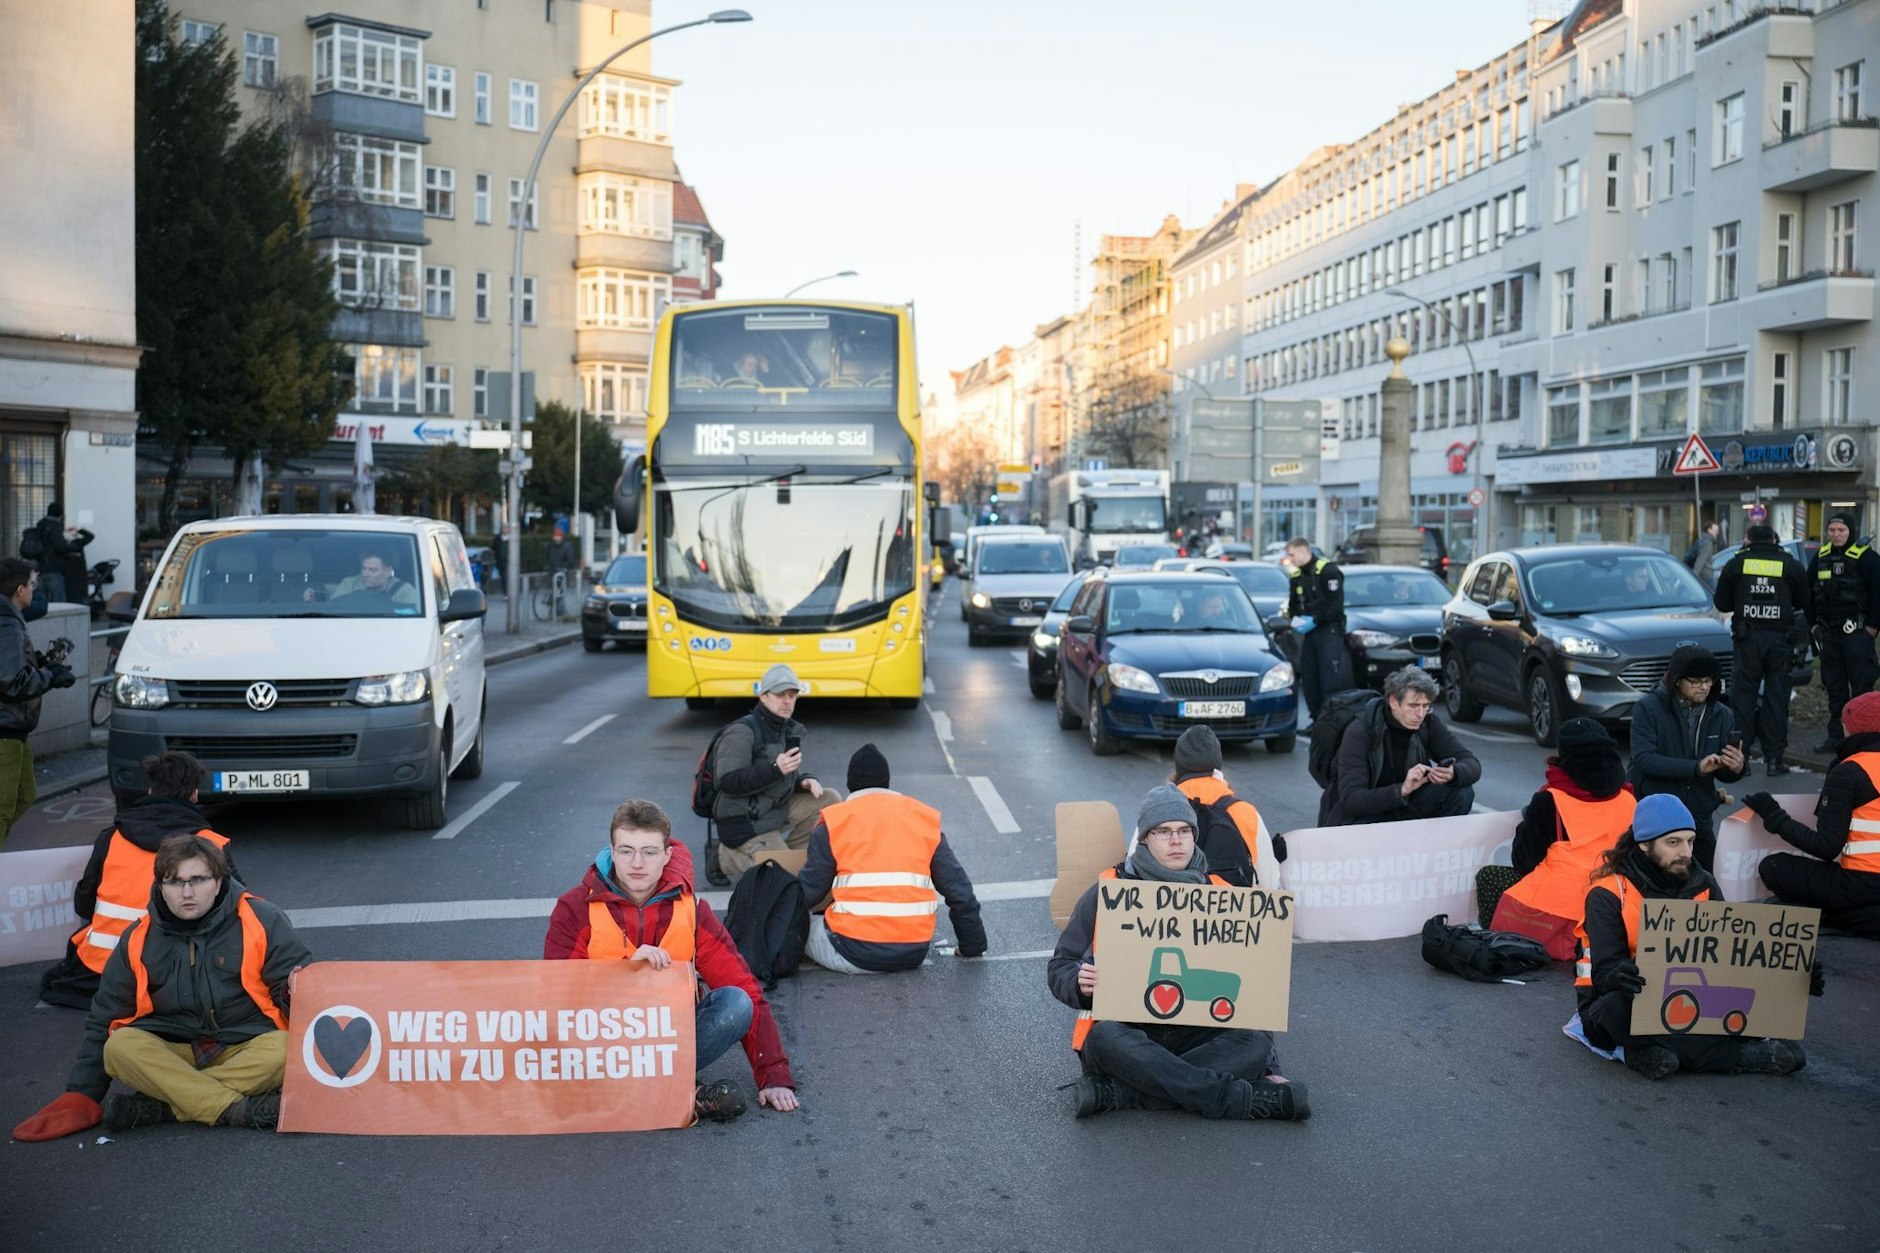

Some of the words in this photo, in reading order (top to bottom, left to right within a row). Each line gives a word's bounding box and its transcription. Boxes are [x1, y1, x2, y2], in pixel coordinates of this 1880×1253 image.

[695, 424, 735, 455] M85
[738, 431, 750, 446] S
[754, 430, 834, 446] Lichterfelde
[837, 430, 867, 446] Süd
[1744, 443, 1794, 462] REPUBLIC
[1750, 585, 1775, 593] 35224
[1757, 577, 1768, 585] BE
[1744, 605, 1780, 619] POLIZEI
[1186, 704, 1193, 714] B
[1201, 704, 1214, 713] AF
[1217, 704, 1244, 713] 2760
[229, 775, 238, 788] P
[249, 774, 269, 788] ML
[273, 774, 302, 787] 801
[1101, 885, 1144, 911] WIR
[1156, 885, 1246, 915] DÜRFEN
[1249, 890, 1294, 920] DAS
[1193, 919, 1261, 947] HABEN
[1643, 904, 1676, 932] Wir
[1686, 904, 1756, 935] dürfen
[1768, 910, 1816, 941] das
[1665, 936, 1719, 963] WIR
[1730, 937, 1814, 973] HABEN
[387, 1010, 467, 1043] WEG
[476, 1009, 548, 1043] VON
[557, 1006, 678, 1042] FOSSIL
[387, 1048, 451, 1082] HIN
[459, 1048, 504, 1082] ZU
[514, 1043, 678, 1081] GERECHT
